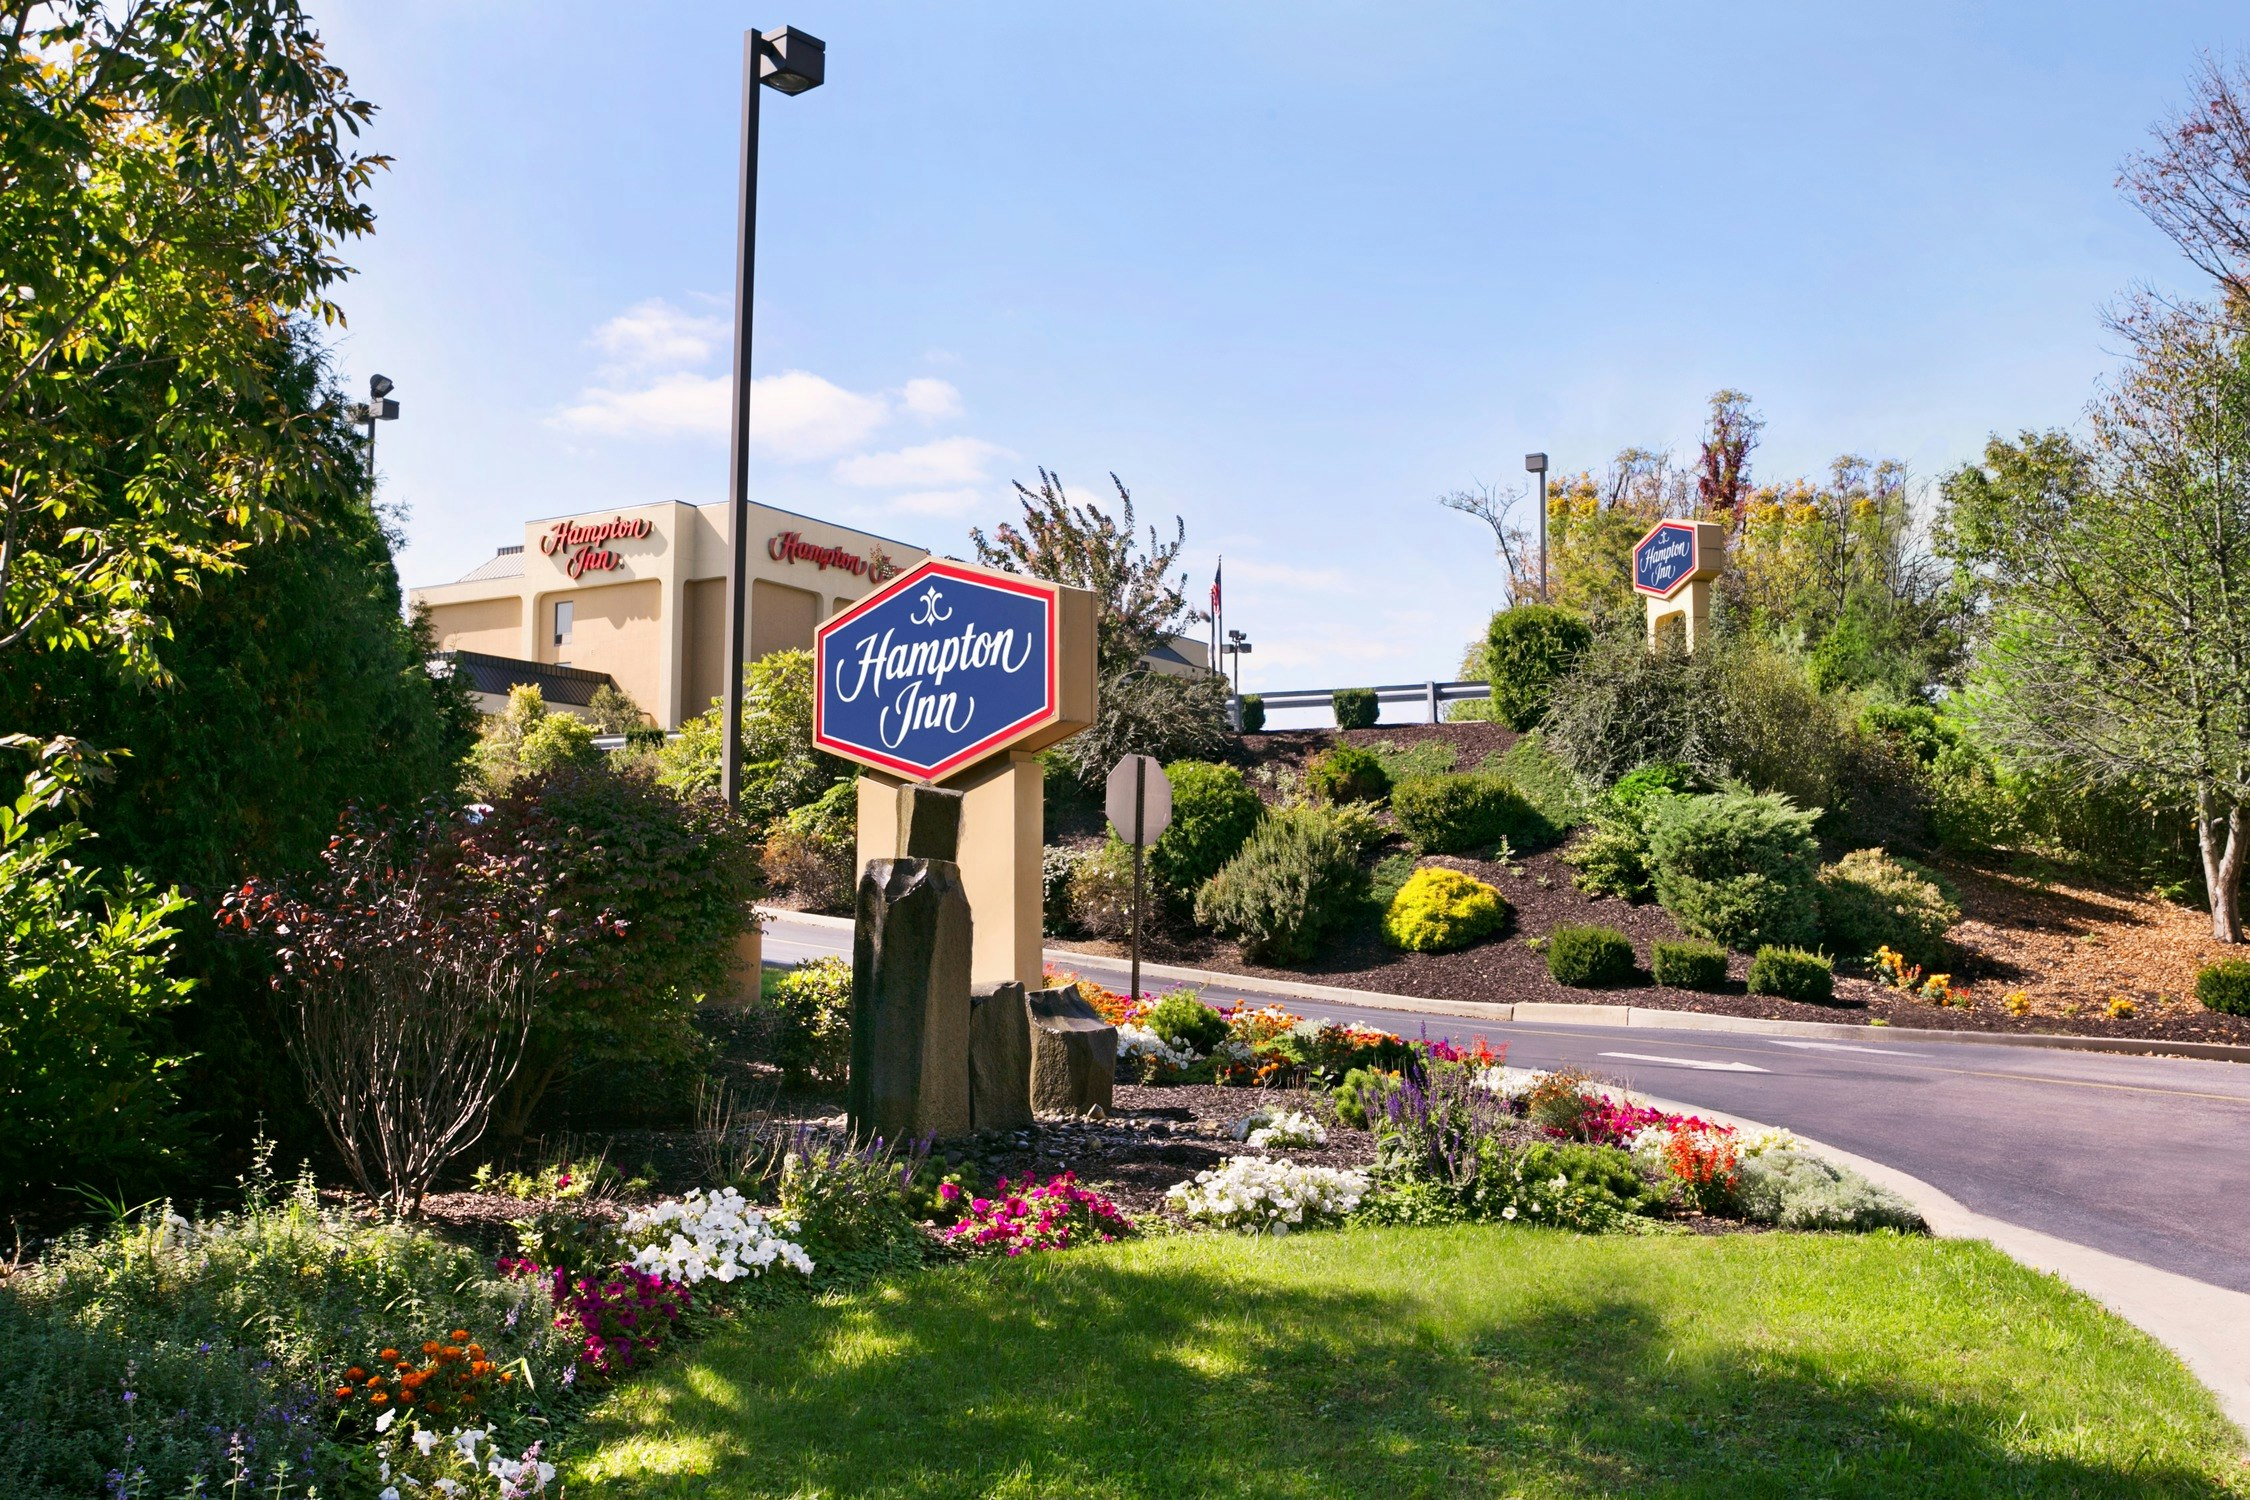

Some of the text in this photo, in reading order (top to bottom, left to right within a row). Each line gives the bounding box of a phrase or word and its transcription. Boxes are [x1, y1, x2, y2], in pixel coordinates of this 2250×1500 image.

[540, 515, 653, 556] Hampton
[768, 531, 867, 575] Hampton
[566, 545, 620, 580] Inn
[1640, 541, 1690, 573] Hampton
[1651, 562, 1676, 586] Inn
[836, 622, 1032, 702] Hampton
[880, 680, 975, 749] Inn
